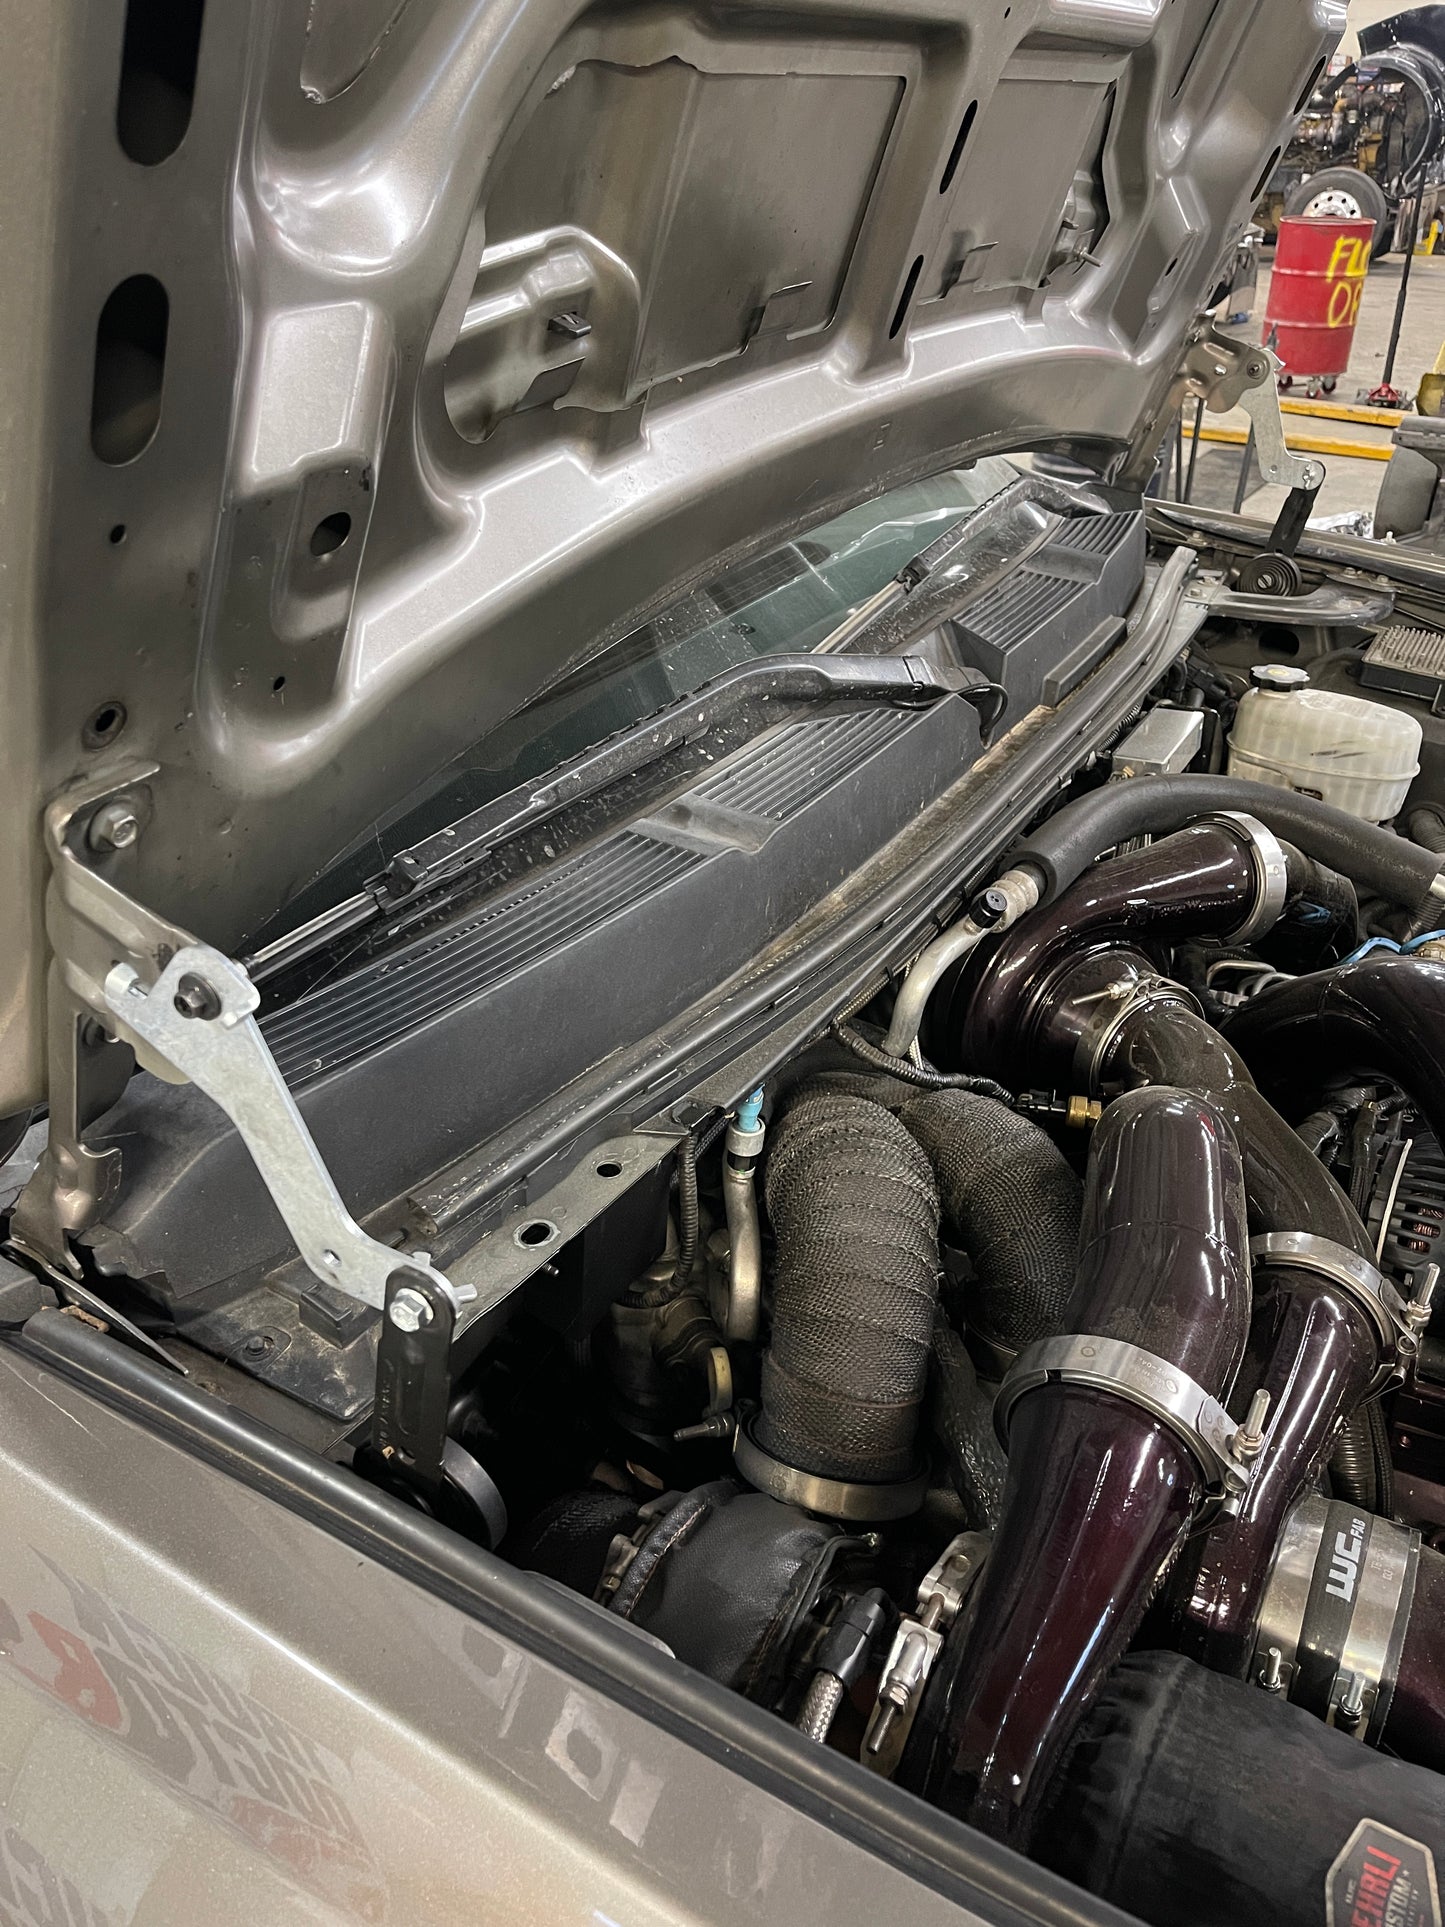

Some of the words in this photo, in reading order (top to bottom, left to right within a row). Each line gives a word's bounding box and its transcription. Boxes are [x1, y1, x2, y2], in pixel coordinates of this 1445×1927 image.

[1350, 1518, 1366, 1540] FAB
[1351, 1845, 1401, 1927] EHRLI
[1384, 1877, 1412, 1927] STOM
